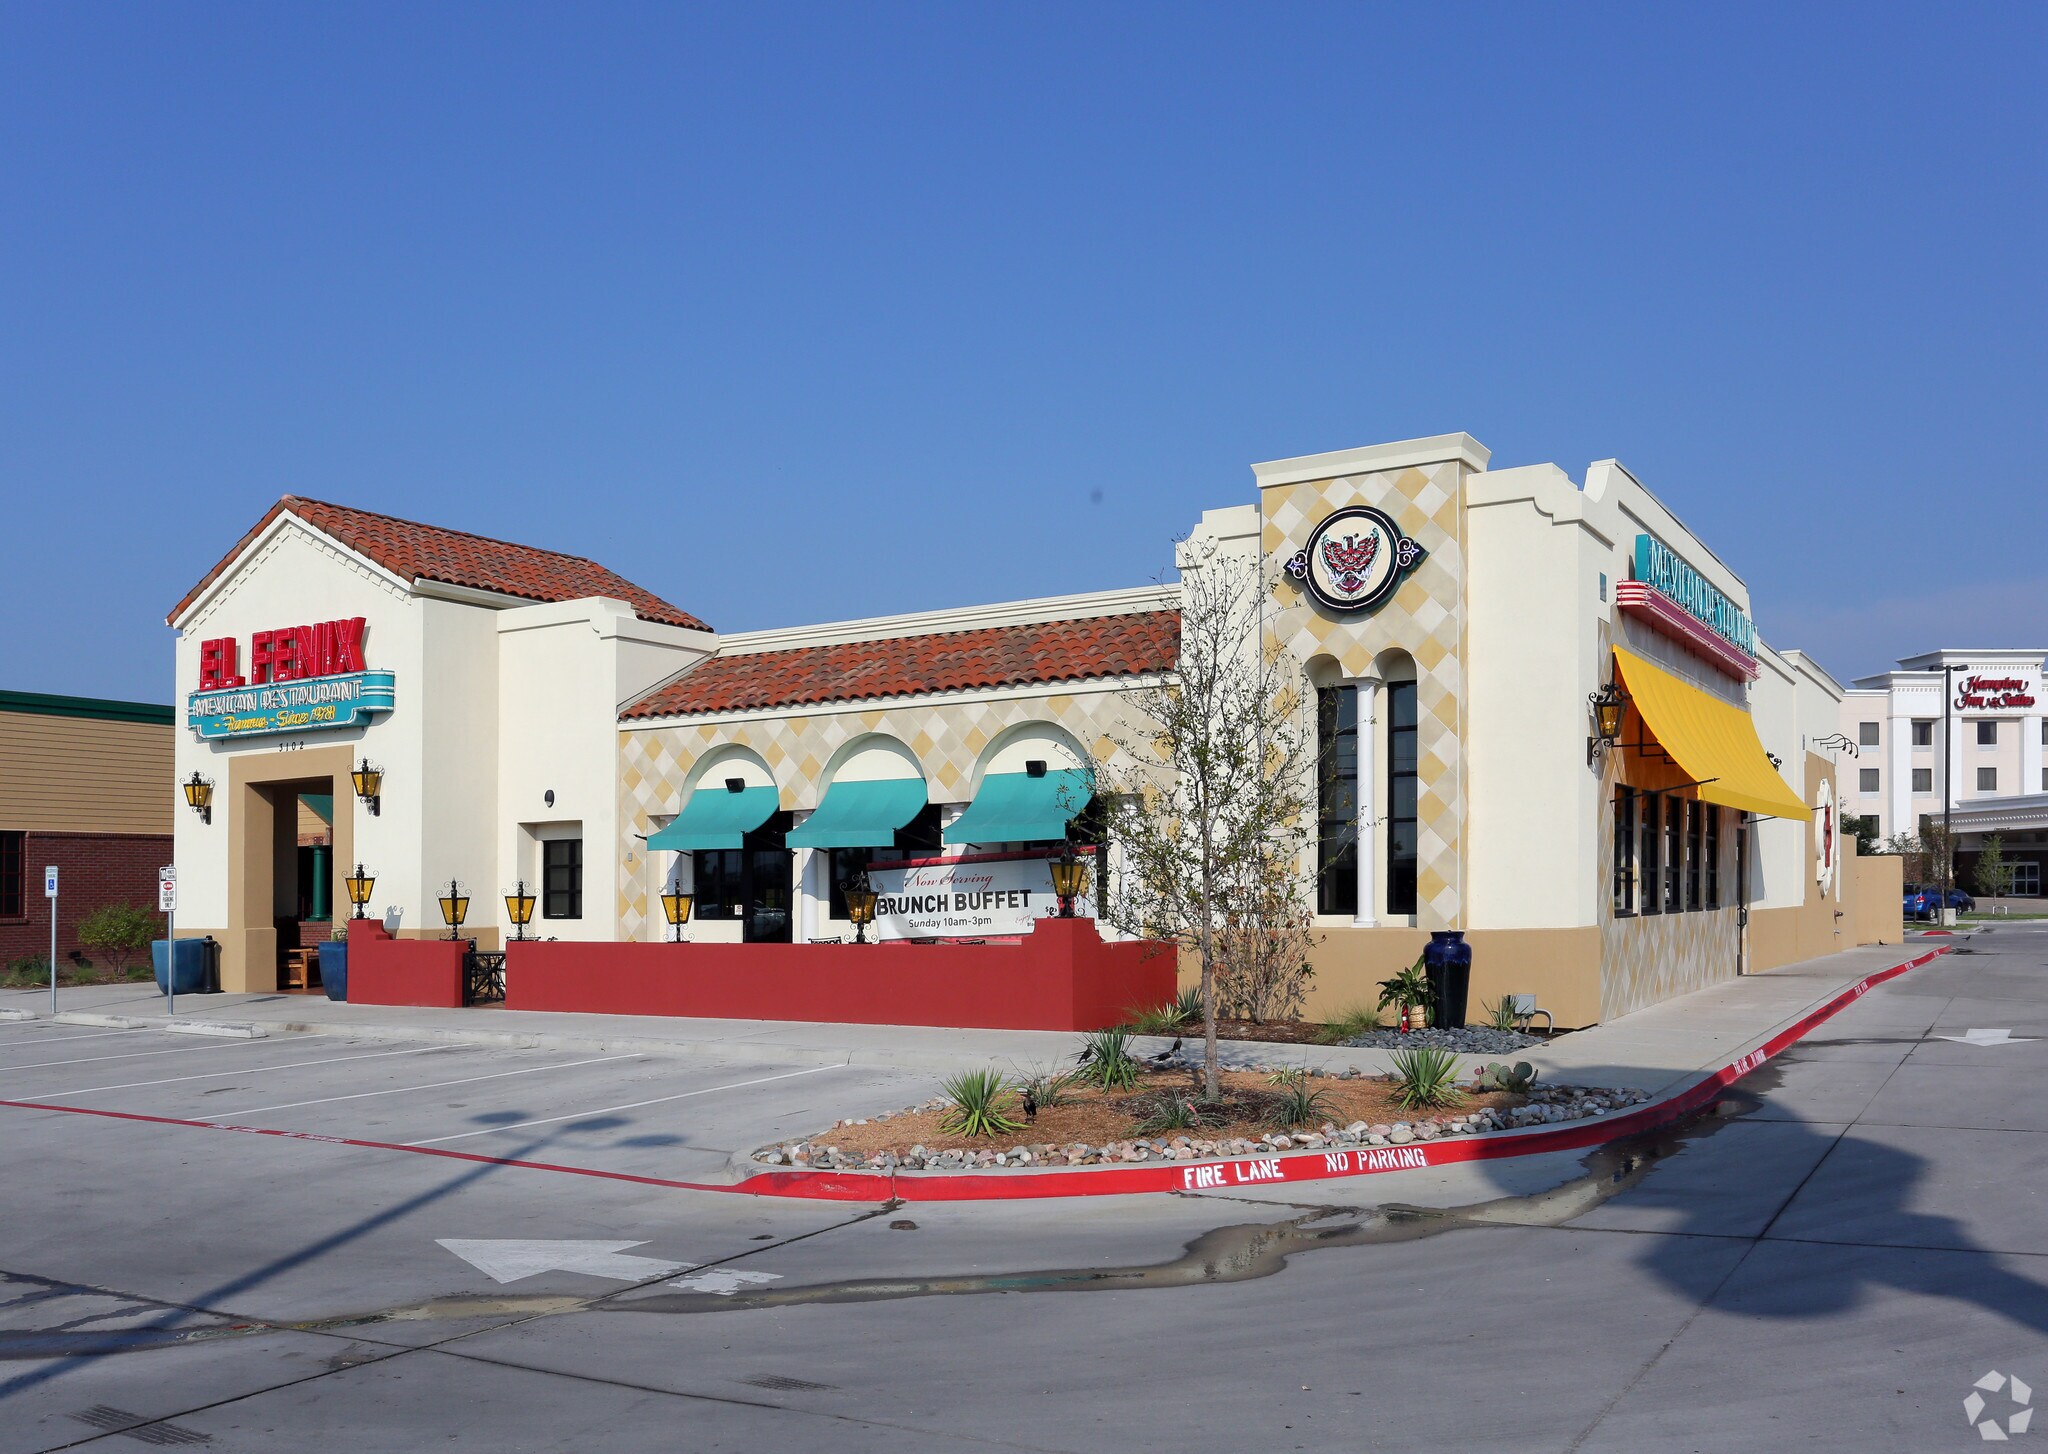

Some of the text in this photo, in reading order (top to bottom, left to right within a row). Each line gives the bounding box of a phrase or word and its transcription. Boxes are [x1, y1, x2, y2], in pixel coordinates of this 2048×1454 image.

[200, 616, 367, 692] EL FENIX
[1958, 675, 2029, 694] Hampton
[193, 681, 362, 717] MEXICAN RESTAURANT
[1954, 693, 1989, 711] Inn
[1998, 692, 2036, 709] Suites
[275, 709, 309, 727] Since
[279, 740, 305, 753] 3102
[905, 872, 995, 892] Now Serving
[876, 893, 949, 916] BRUNCH
[954, 889, 1032, 912] BUFFET
[908, 916, 992, 929] Sunday 10am-3pm
[1183, 1148, 1427, 1189] FIRE LANE NO PARKING
